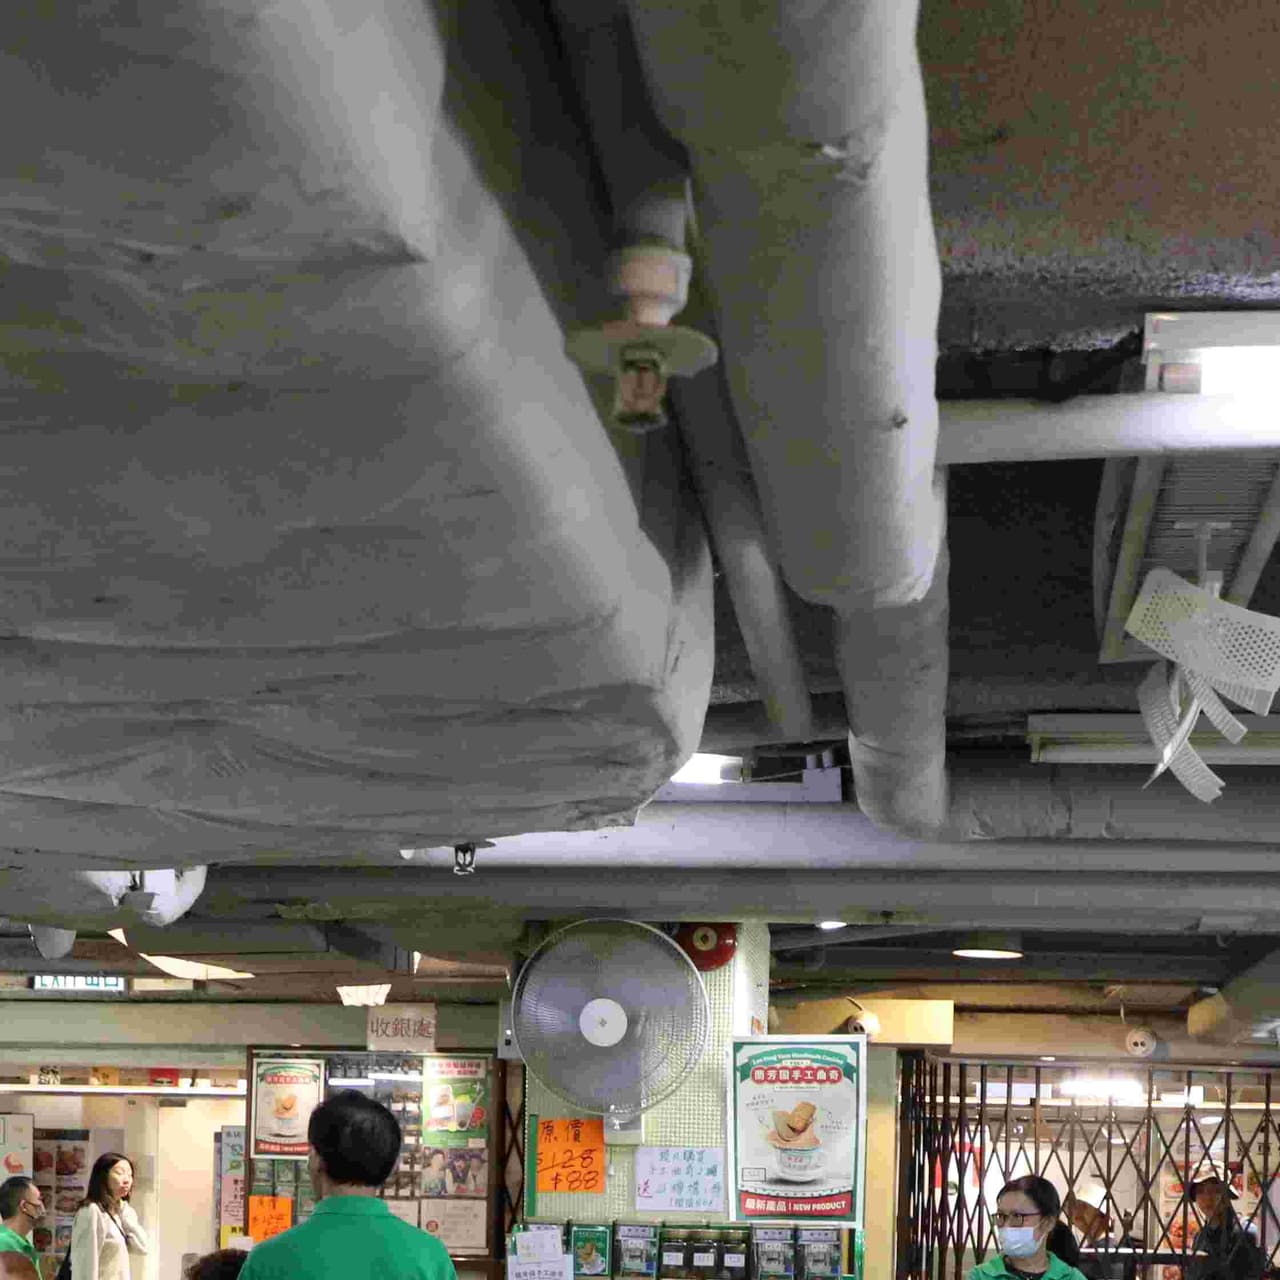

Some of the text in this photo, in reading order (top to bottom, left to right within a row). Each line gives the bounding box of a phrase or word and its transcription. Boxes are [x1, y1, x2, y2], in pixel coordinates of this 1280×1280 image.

[550, 1169, 600, 1191] $88
[794, 1202, 811, 1211] NEW
[812, 1199, 846, 1211] PRODUCT
